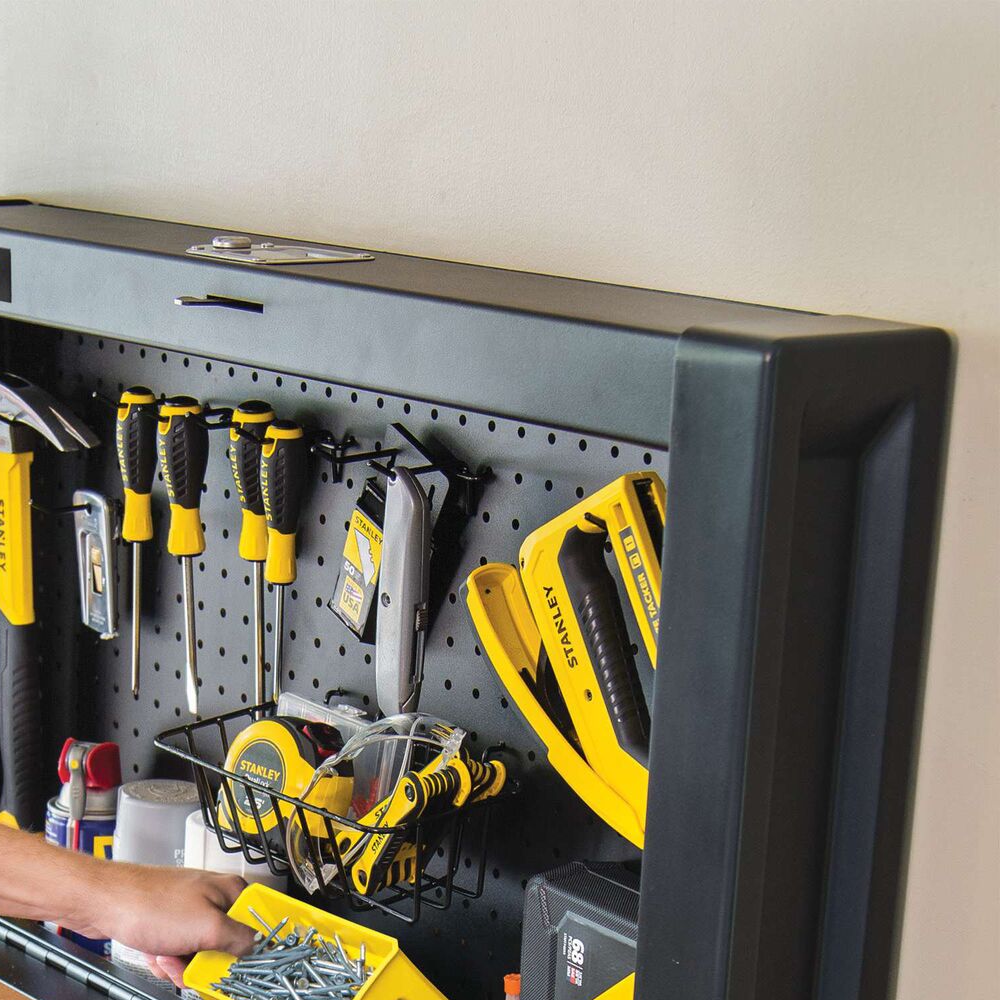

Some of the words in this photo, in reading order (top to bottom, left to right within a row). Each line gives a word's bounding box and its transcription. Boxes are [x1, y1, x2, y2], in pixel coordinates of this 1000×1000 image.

[116, 422, 128, 482] STANLEY
[160, 438, 175, 498] STANLEY
[230, 443, 246, 503] STANLEY
[261, 460, 273, 522] STANLEY
[355, 515, 384, 546] STANLEY
[342, 592, 360, 615] USA
[637, 571, 658, 619] TACKER
[542, 585, 579, 669] STANLEY
[240, 759, 281, 782] STANLEY
[571, 938, 585, 966] 68
